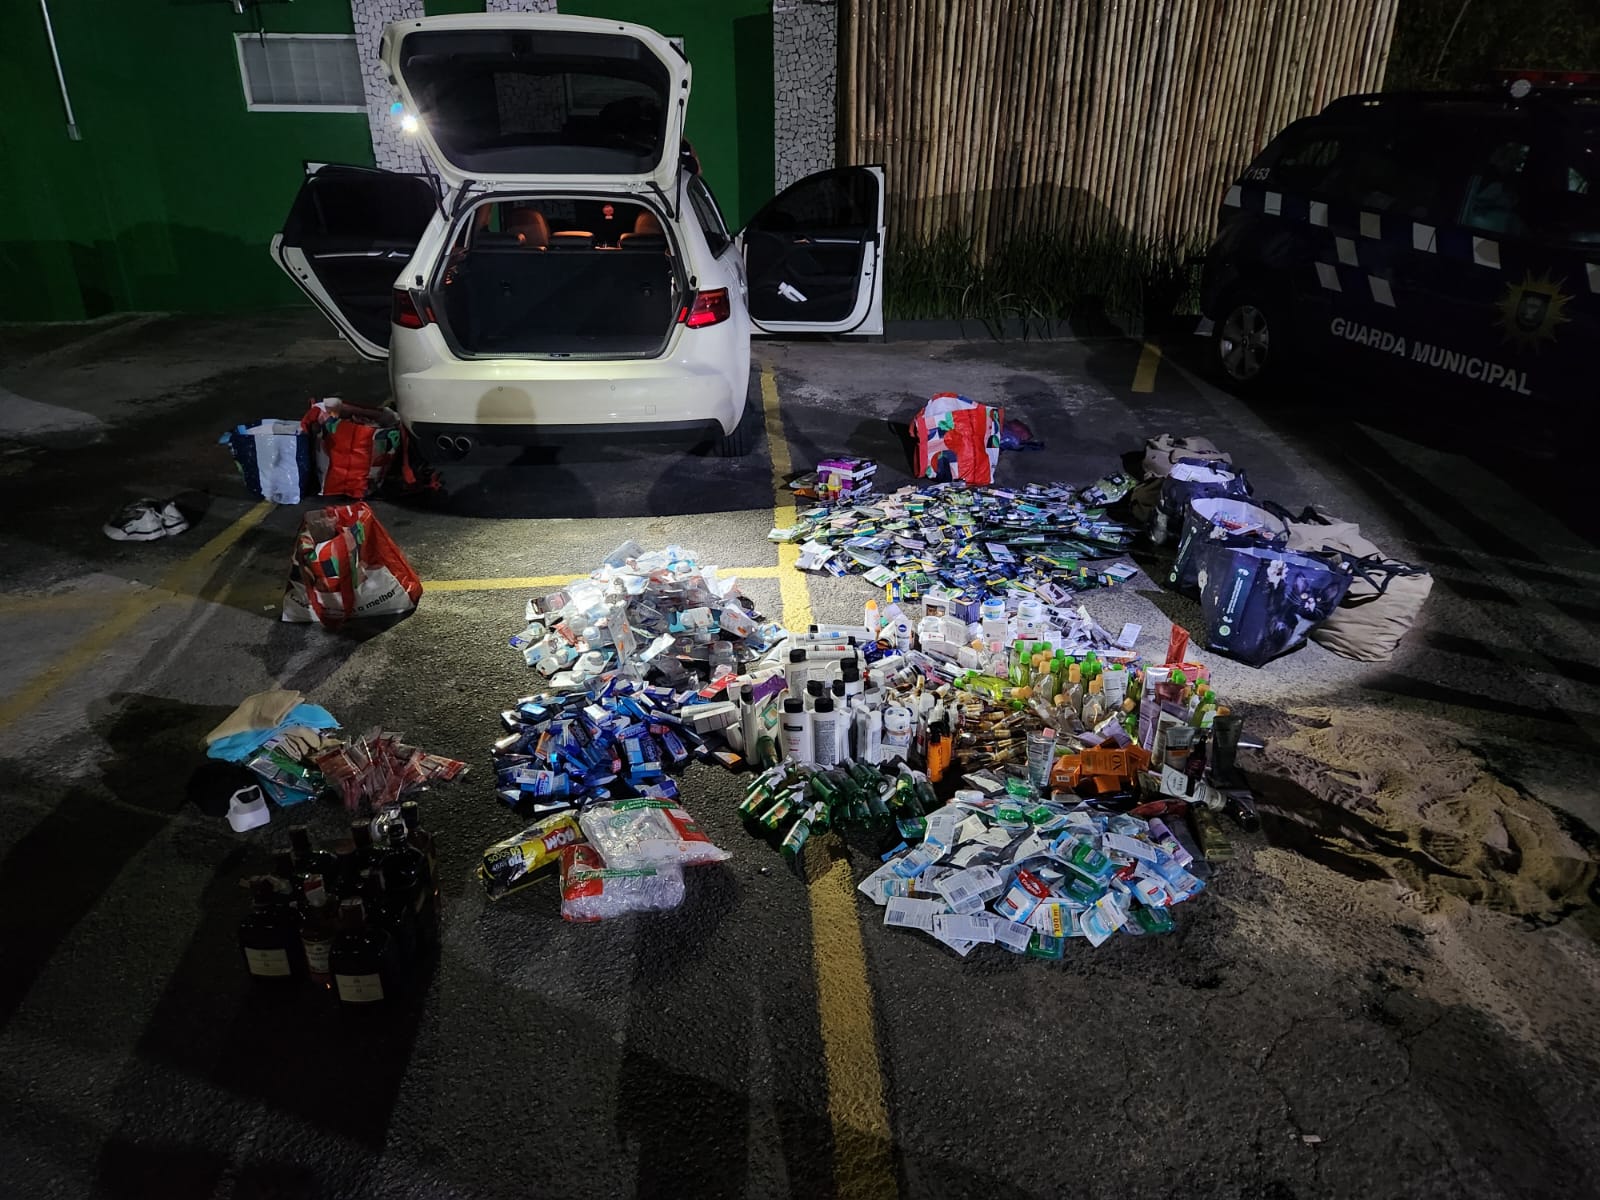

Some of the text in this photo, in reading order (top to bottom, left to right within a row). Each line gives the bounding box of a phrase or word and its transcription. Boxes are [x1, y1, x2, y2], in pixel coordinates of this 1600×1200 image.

[1252, 168, 1271, 181] 153
[1329, 316, 1533, 396] GUARDA MUNICIPAL
[366, 589, 396, 610] melhor
